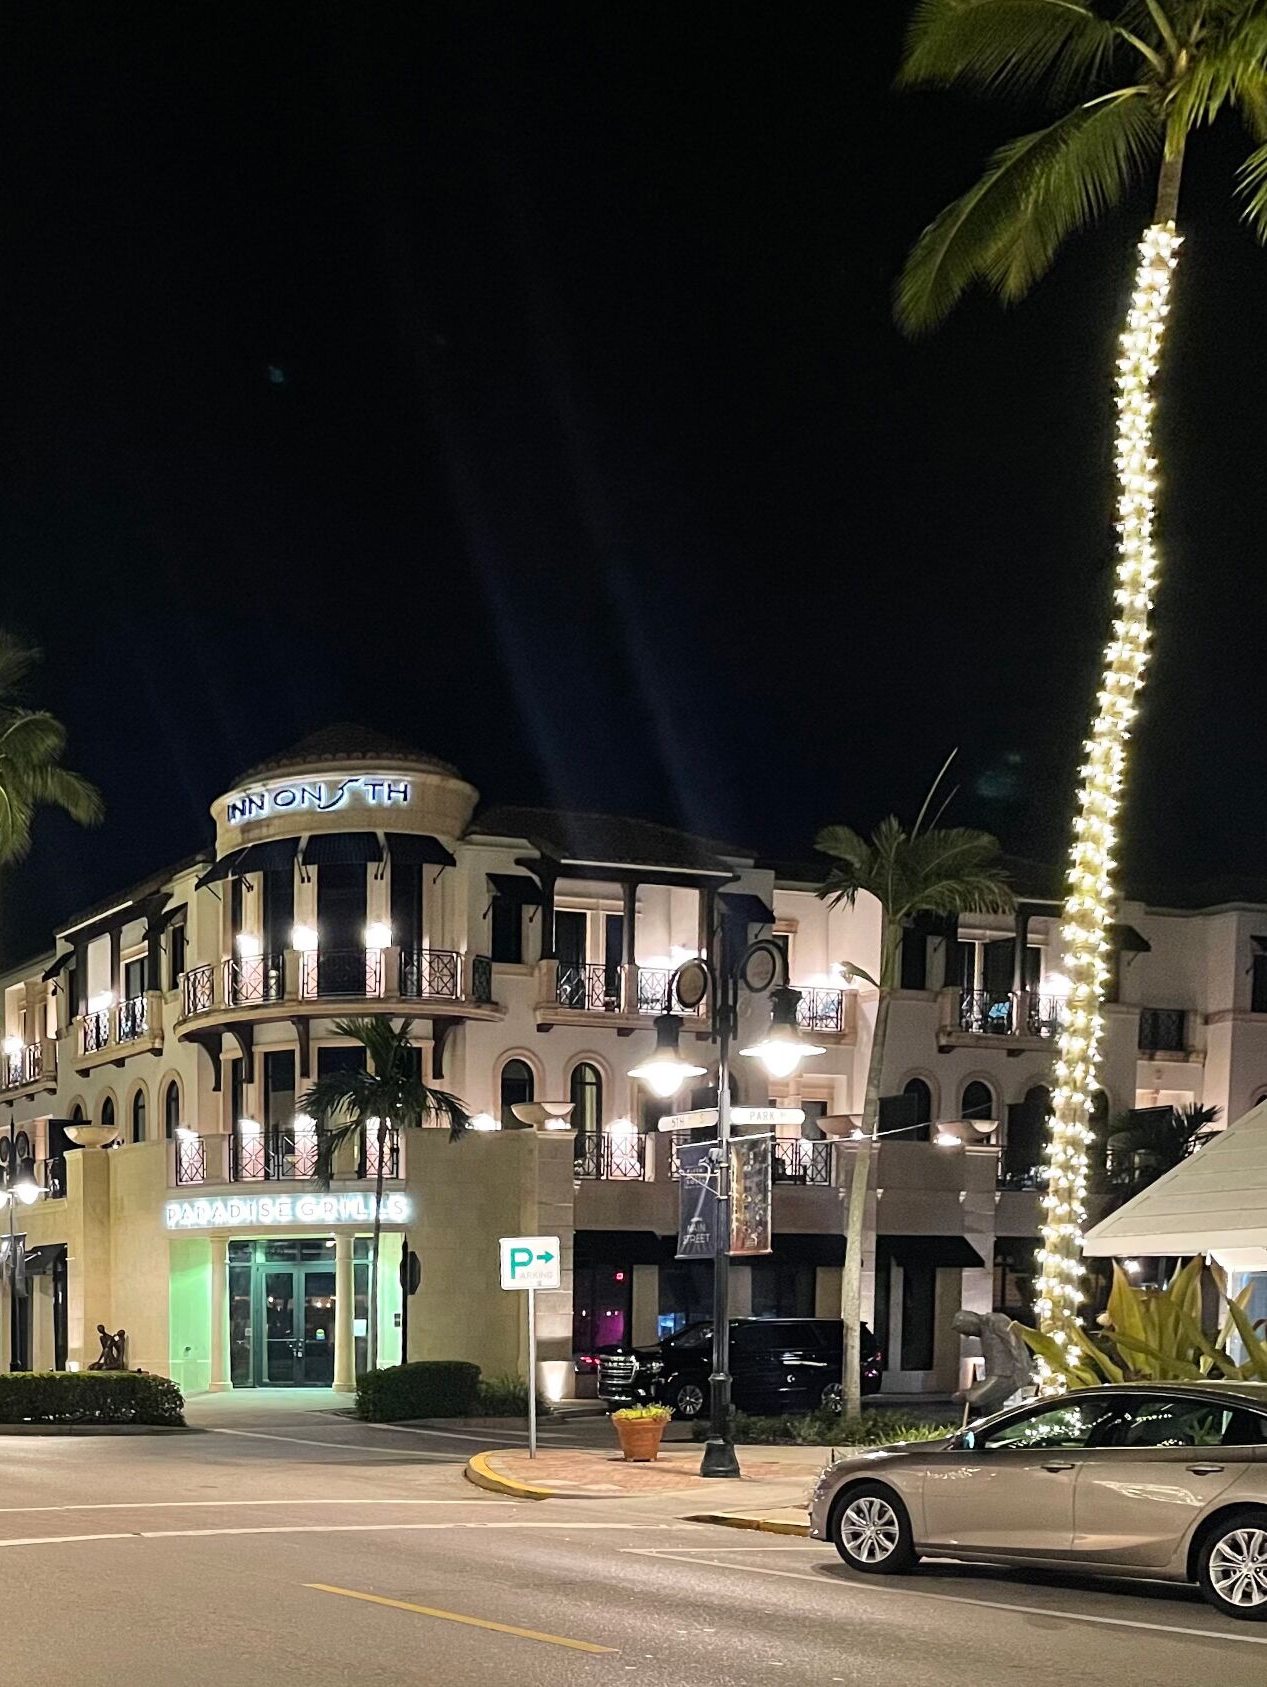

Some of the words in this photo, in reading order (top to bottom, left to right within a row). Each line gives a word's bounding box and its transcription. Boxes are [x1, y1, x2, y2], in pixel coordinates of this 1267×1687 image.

[227, 793, 265, 822] INN
[273, 783, 323, 807] ON
[749, 1110, 775, 1121] PARK
[167, 1200, 293, 1221] PARADISE
